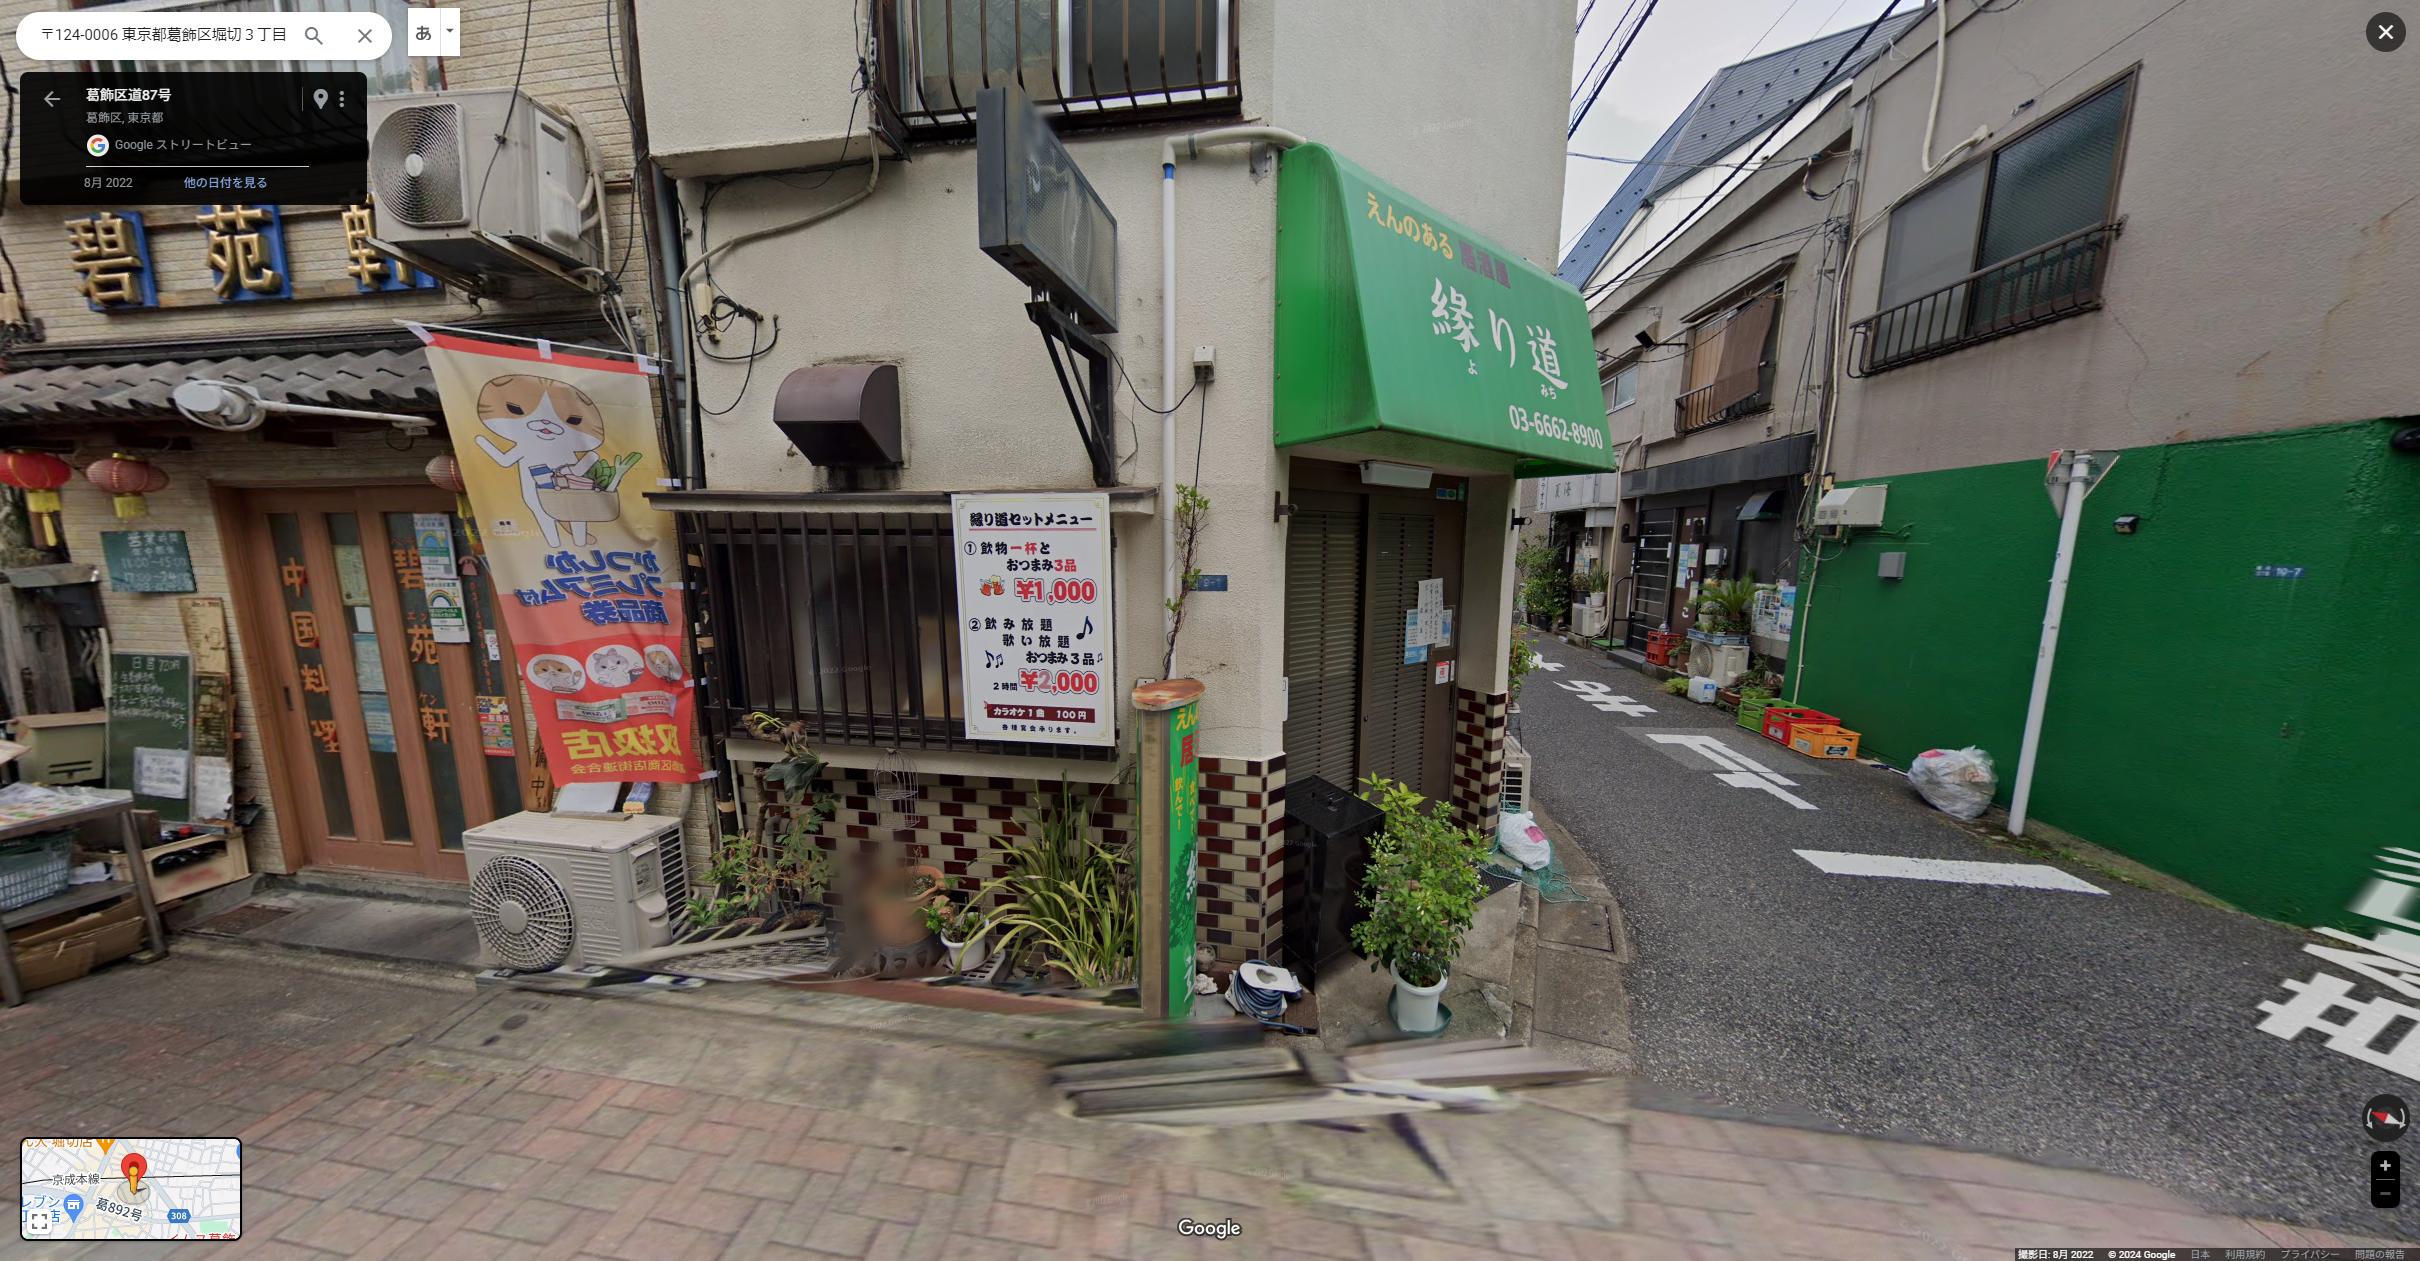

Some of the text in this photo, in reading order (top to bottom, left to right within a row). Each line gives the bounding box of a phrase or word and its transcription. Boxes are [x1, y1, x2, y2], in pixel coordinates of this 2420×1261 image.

[1367, 191, 1454, 259] えんのある
[1431, 277, 1569, 390] 縁り道
[1541, 384, 1557, 400] みち
[1508, 404, 1604, 450] 03-6662-8900
[969, 512, 1093, 527] 縁り道セットメニュー
[980, 541, 1051, 556] 飲物一杯と
[1006, 558, 1077, 572] おつまみ3品
[1015, 579, 1096, 603] ¥1,000
[984, 618, 1053, 632] 飲み放題
[1002, 634, 1070, 648] 歌い放題
[282, 557, 341, 753] 中国料理
[1026, 652, 1095, 666] おつまみ3品
[993, 671, 1098, 693] 2時間 ¥2,000
[994, 707, 1087, 720] カラオケ1曲 100円
